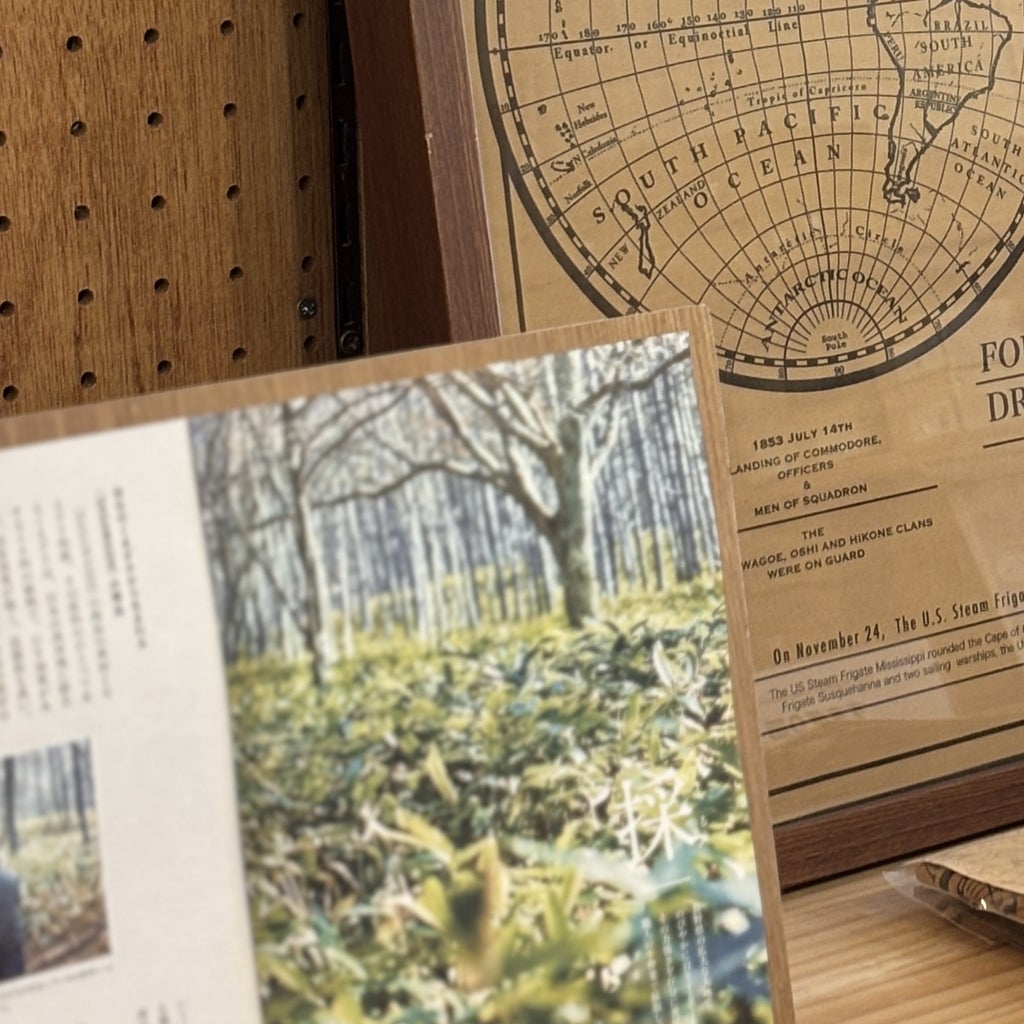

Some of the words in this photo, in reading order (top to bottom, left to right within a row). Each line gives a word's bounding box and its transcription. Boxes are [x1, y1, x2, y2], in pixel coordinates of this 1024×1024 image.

[752, 435, 783, 451] 1853
[787, 429, 818, 444] JULY
[823, 422, 853, 436] 14TH
[784, 451, 800, 464] OF
[803, 435, 882, 460] COMMODORE,
[777, 460, 835, 480] OFFICERS
[803, 480, 811, 490] &
[754, 503, 780, 517] MEN
[783, 498, 800, 510] OF
[802, 483, 868, 506] SQUADRON
[790, 544, 819, 559] OSHI
[822, 538, 846, 552] AND
[850, 525, 893, 545] HIKONE
[896, 517, 934, 534] CLANS
[801, 527, 824, 540] THE
[767, 564, 801, 580] WERE
[805, 558, 823, 572] ON
[825, 549, 866, 566] GUARD
[773, 648, 790, 666] On
[796, 630, 860, 660] November
[864, 624, 886, 643] 24,
[895, 616, 917, 635] The
[922, 609, 948, 628] U.S.
[952, 599, 989, 621] Steam
[769, 685, 788, 701] The
[790, 680, 805, 694] US
[807, 673, 839, 690] Steam
[840, 665, 873, 684] Frigate
[875, 653, 926, 673] Mississippi
[928, 643, 966, 659] rounded
[968, 637, 983, 649] the
[985, 631, 1009, 647] Cape
